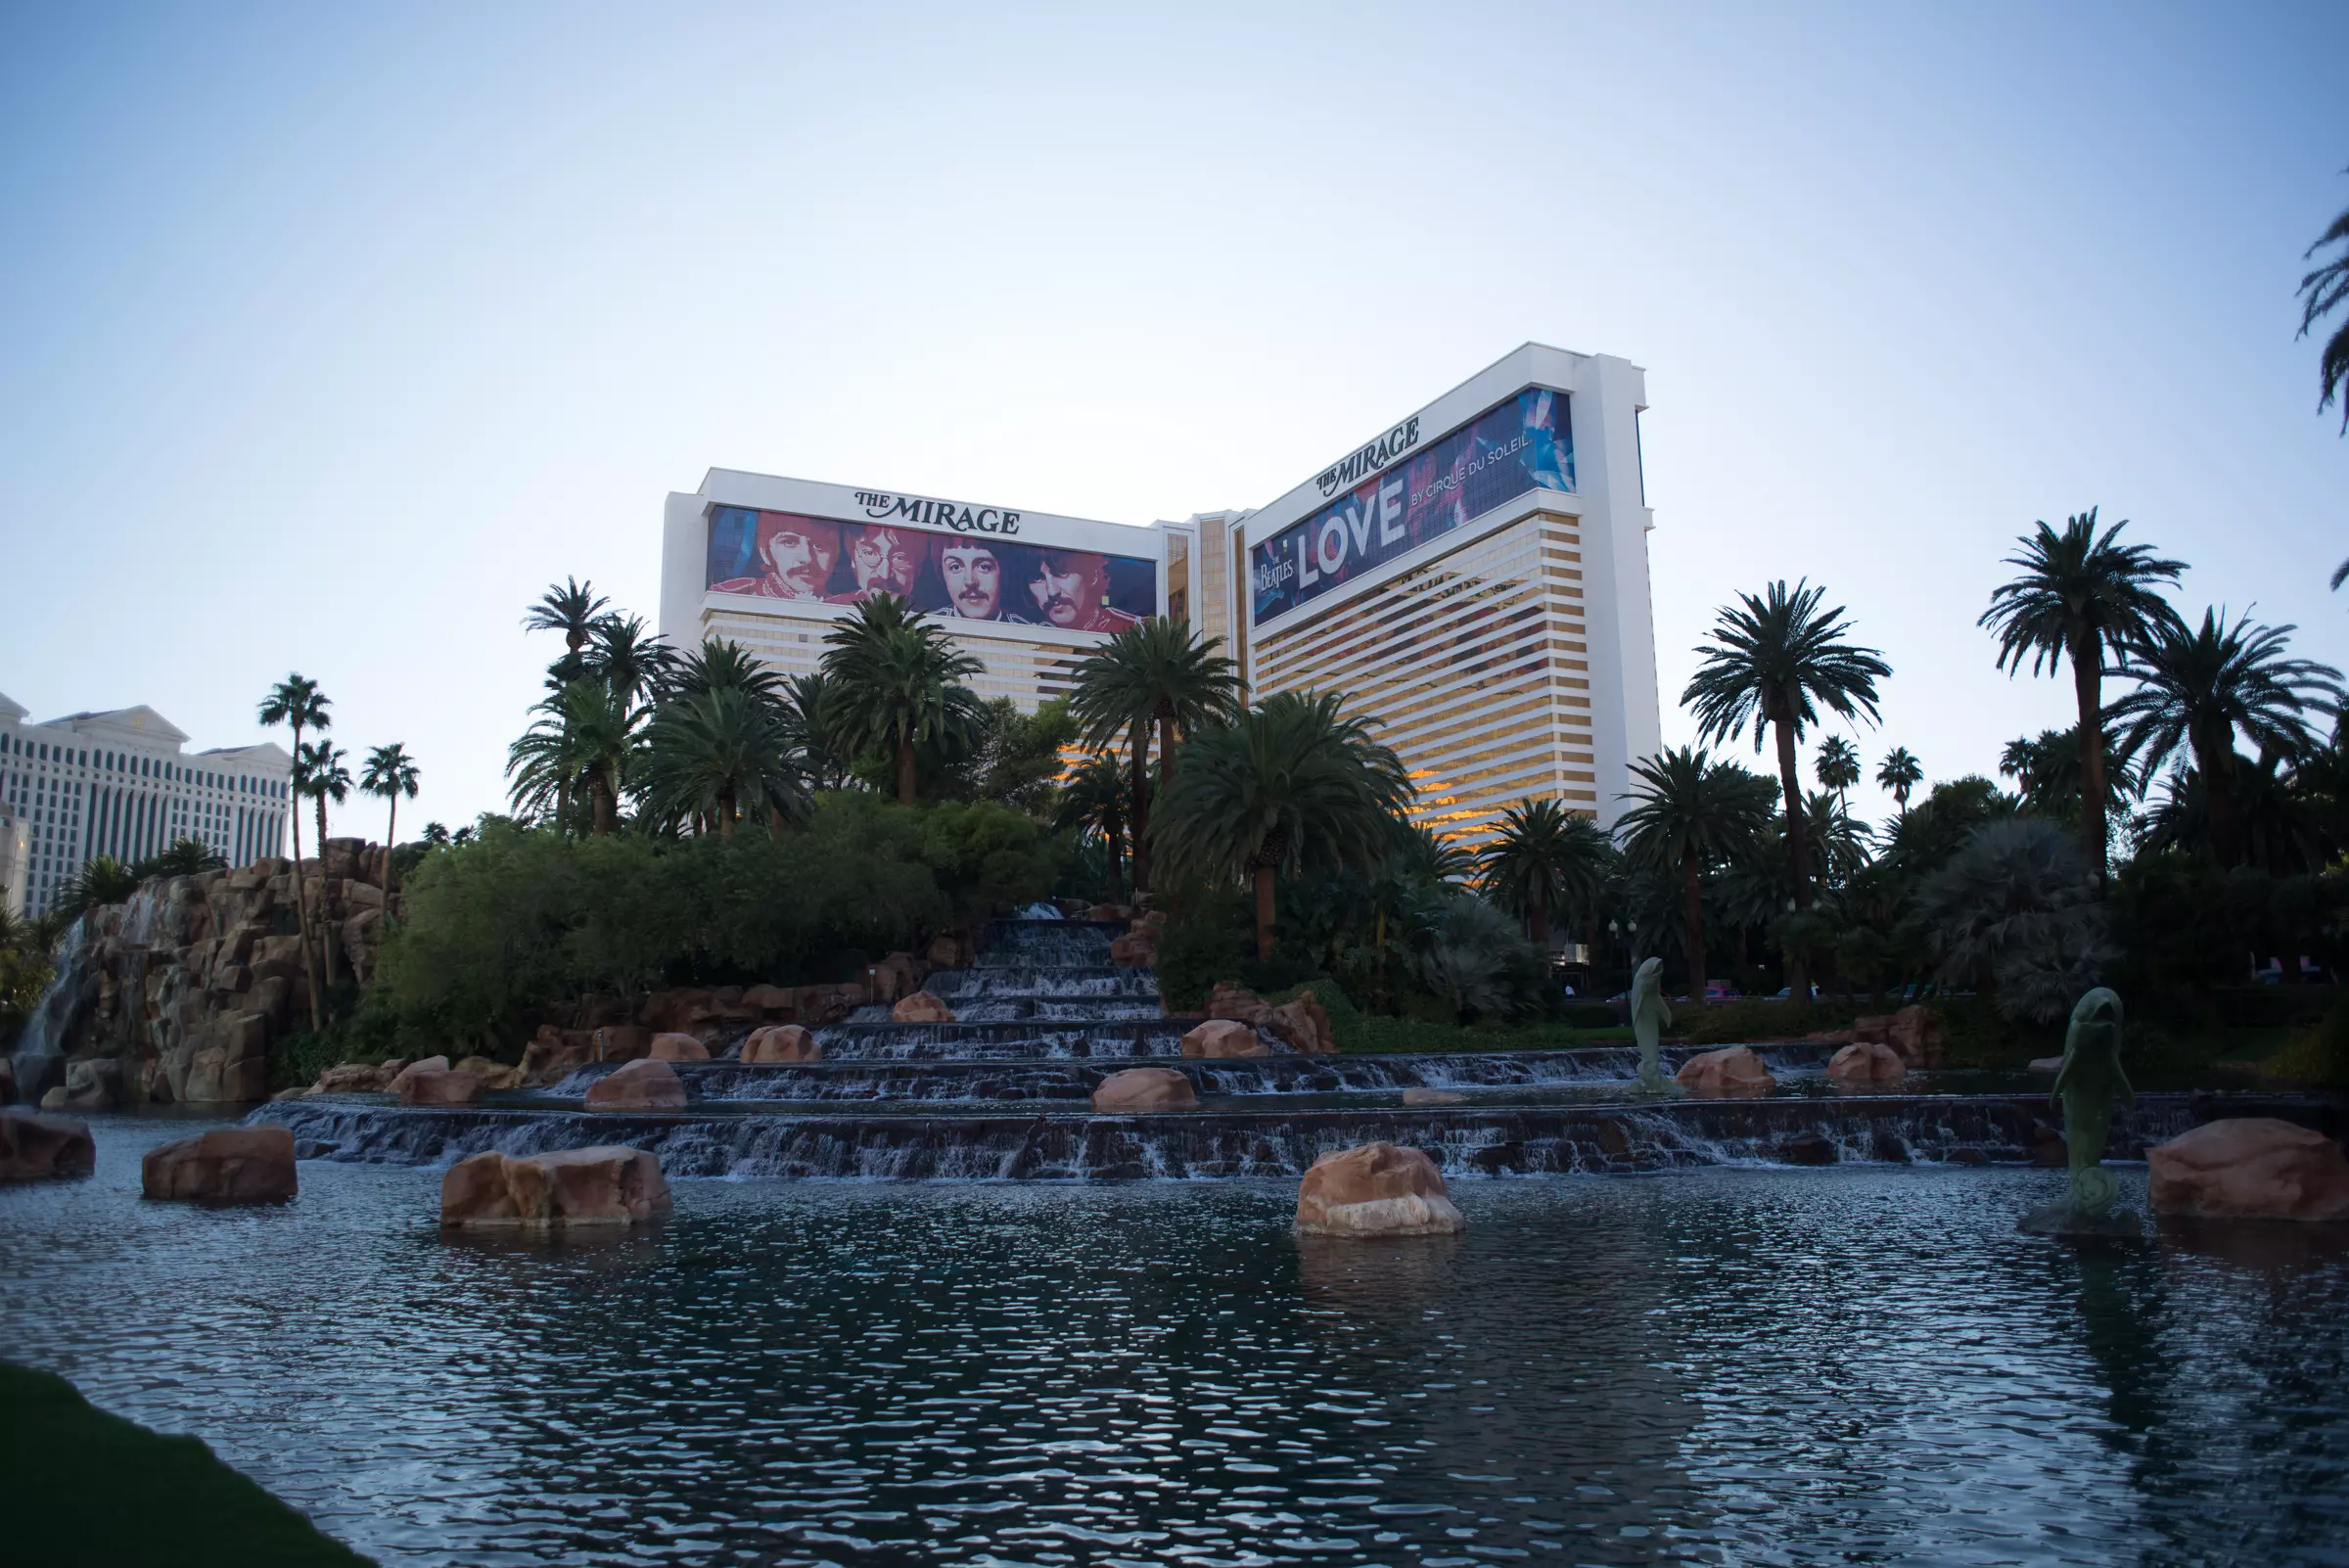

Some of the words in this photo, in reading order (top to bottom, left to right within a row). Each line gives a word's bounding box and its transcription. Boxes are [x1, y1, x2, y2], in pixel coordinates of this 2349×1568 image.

[1323, 417, 1418, 497] MIRAGE
[1411, 489, 1425, 506] BY
[1426, 467, 1465, 497] CIRQUE
[1469, 456, 1485, 476] DU
[1488, 434, 1529, 465] SOLEIL
[1316, 468, 1336, 490] THE
[854, 491, 891, 509] THE
[866, 497, 1020, 535] MIRAGE
[1297, 478, 1405, 589] LOVE
[1261, 559, 1293, 591] BEATLES
